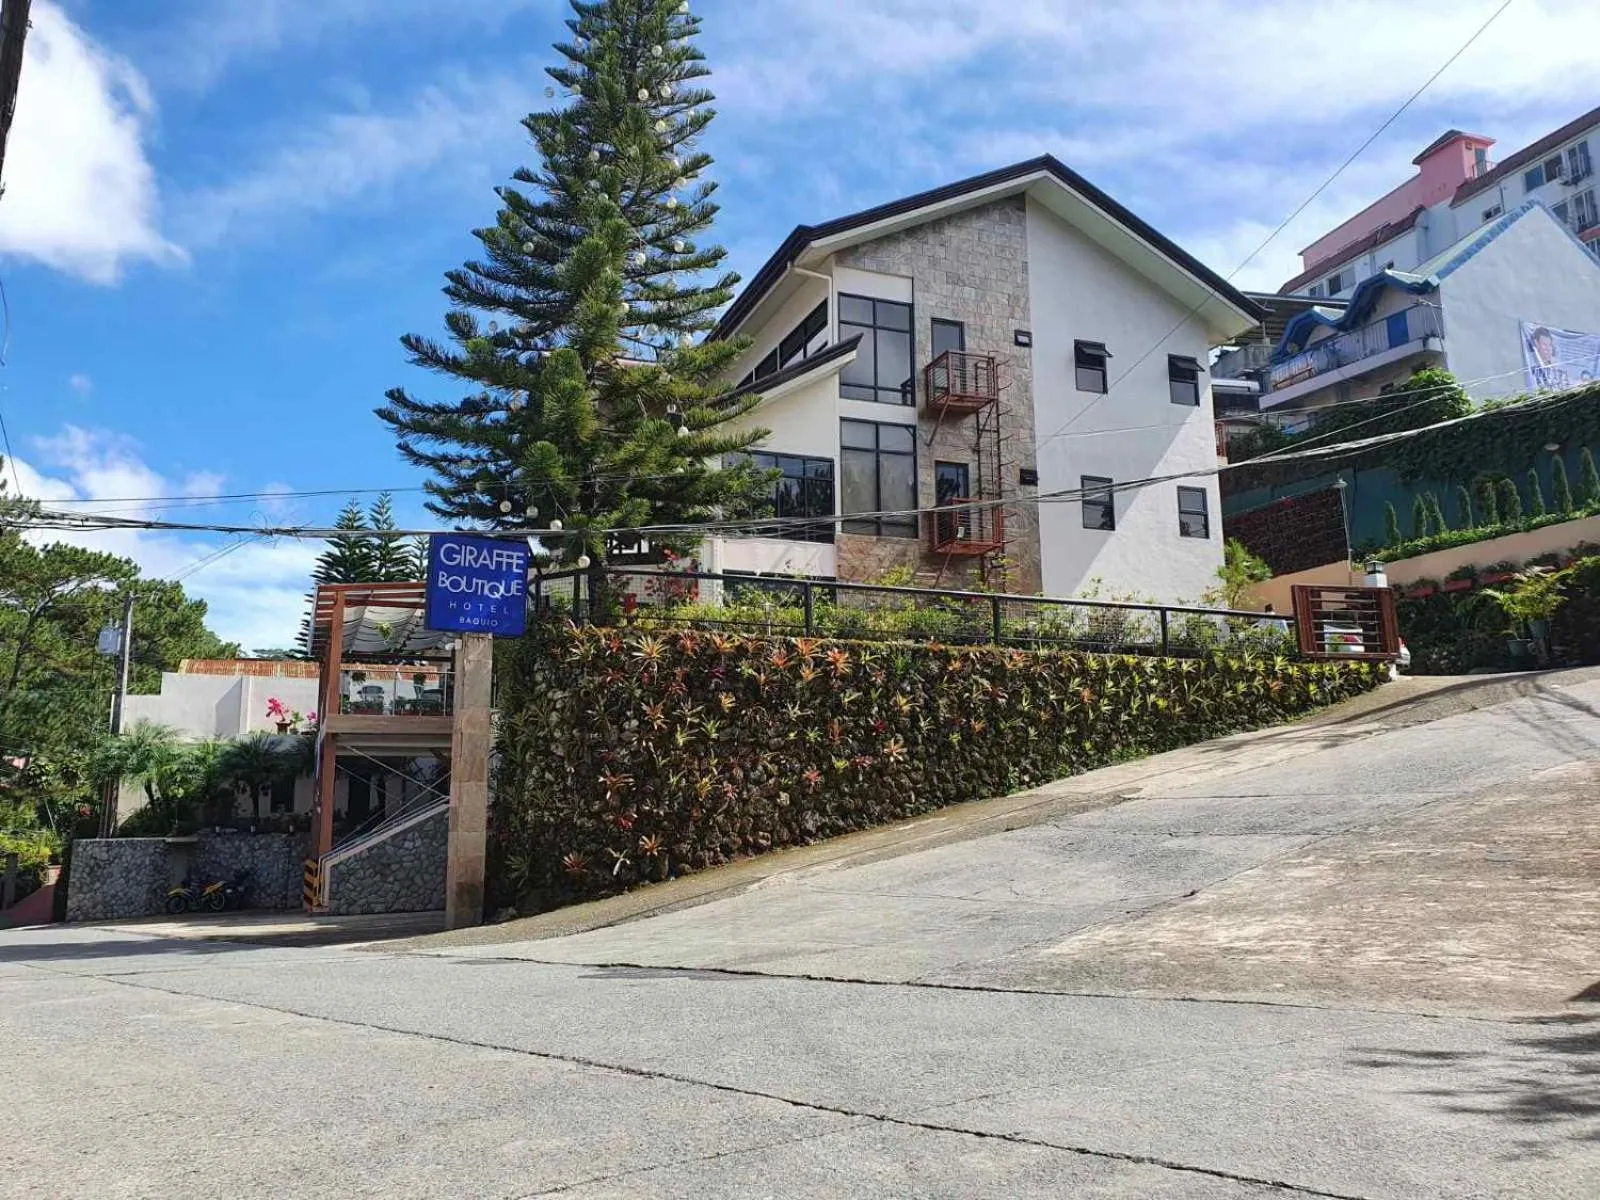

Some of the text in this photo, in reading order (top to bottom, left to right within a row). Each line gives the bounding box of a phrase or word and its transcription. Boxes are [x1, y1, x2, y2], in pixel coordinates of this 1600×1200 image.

[440, 543, 524, 573] GIRAFFE
[438, 571, 523, 599] BOUTIQUE
[449, 601, 509, 614] HOTEL
